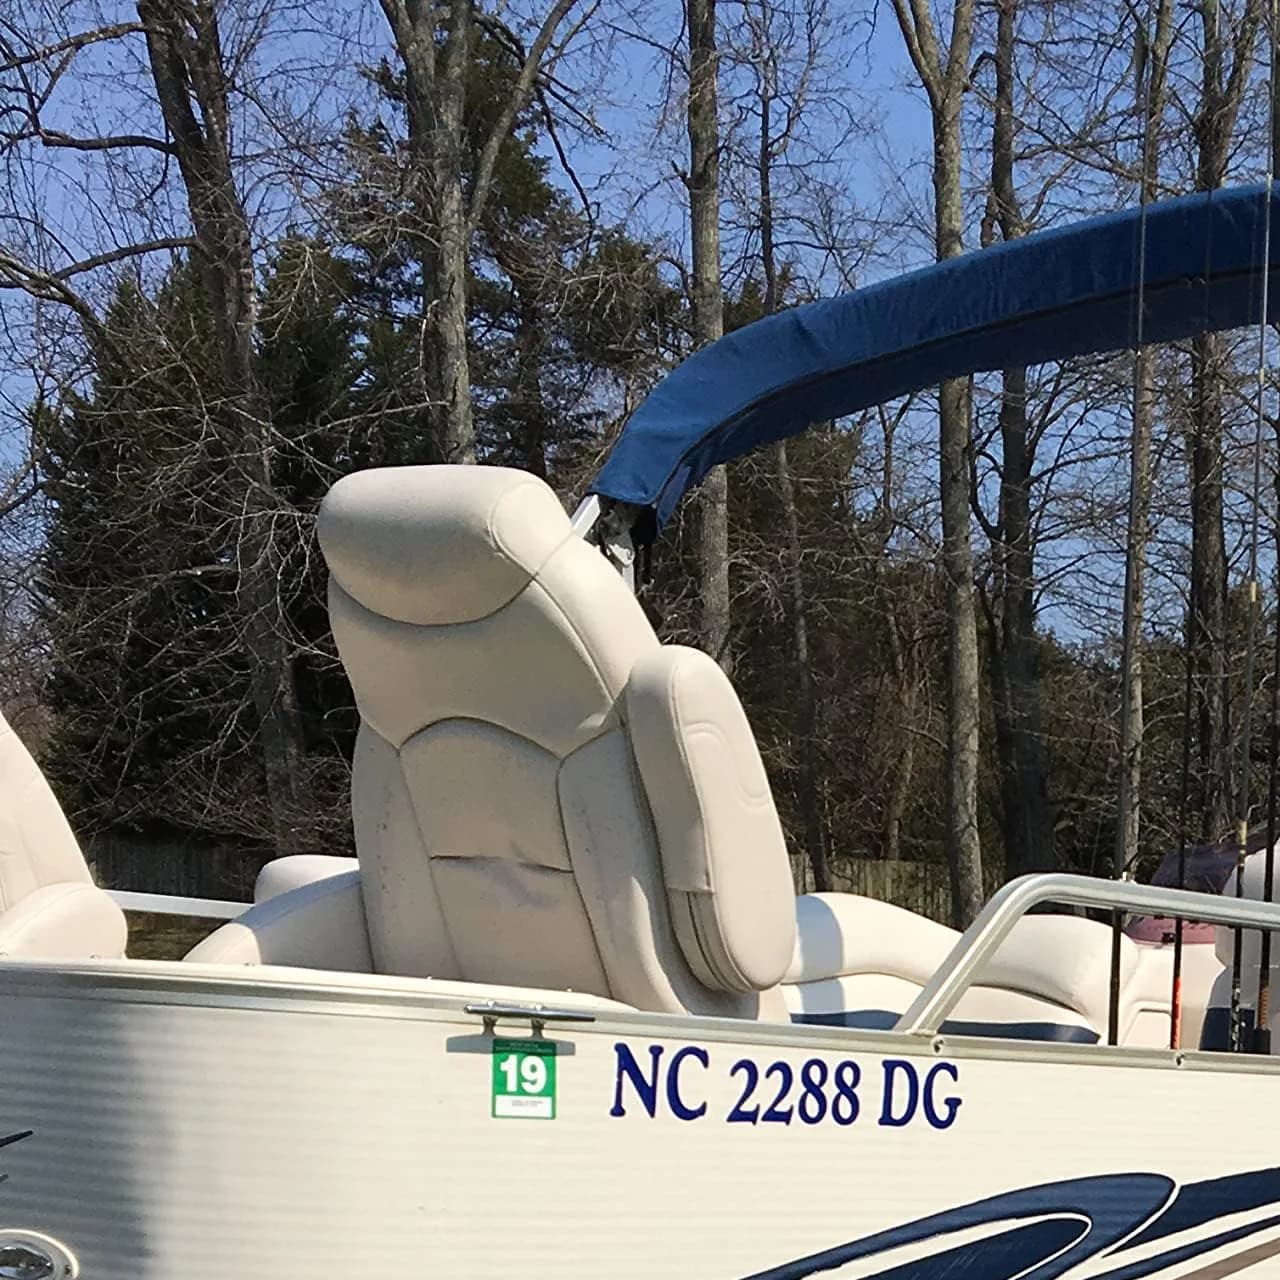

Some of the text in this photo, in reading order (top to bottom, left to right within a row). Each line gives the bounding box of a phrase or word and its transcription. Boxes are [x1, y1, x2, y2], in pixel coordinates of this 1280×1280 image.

[499, 1054, 547, 1094] 19
[609, 1042, 962, 1130] NC 2288 DG
